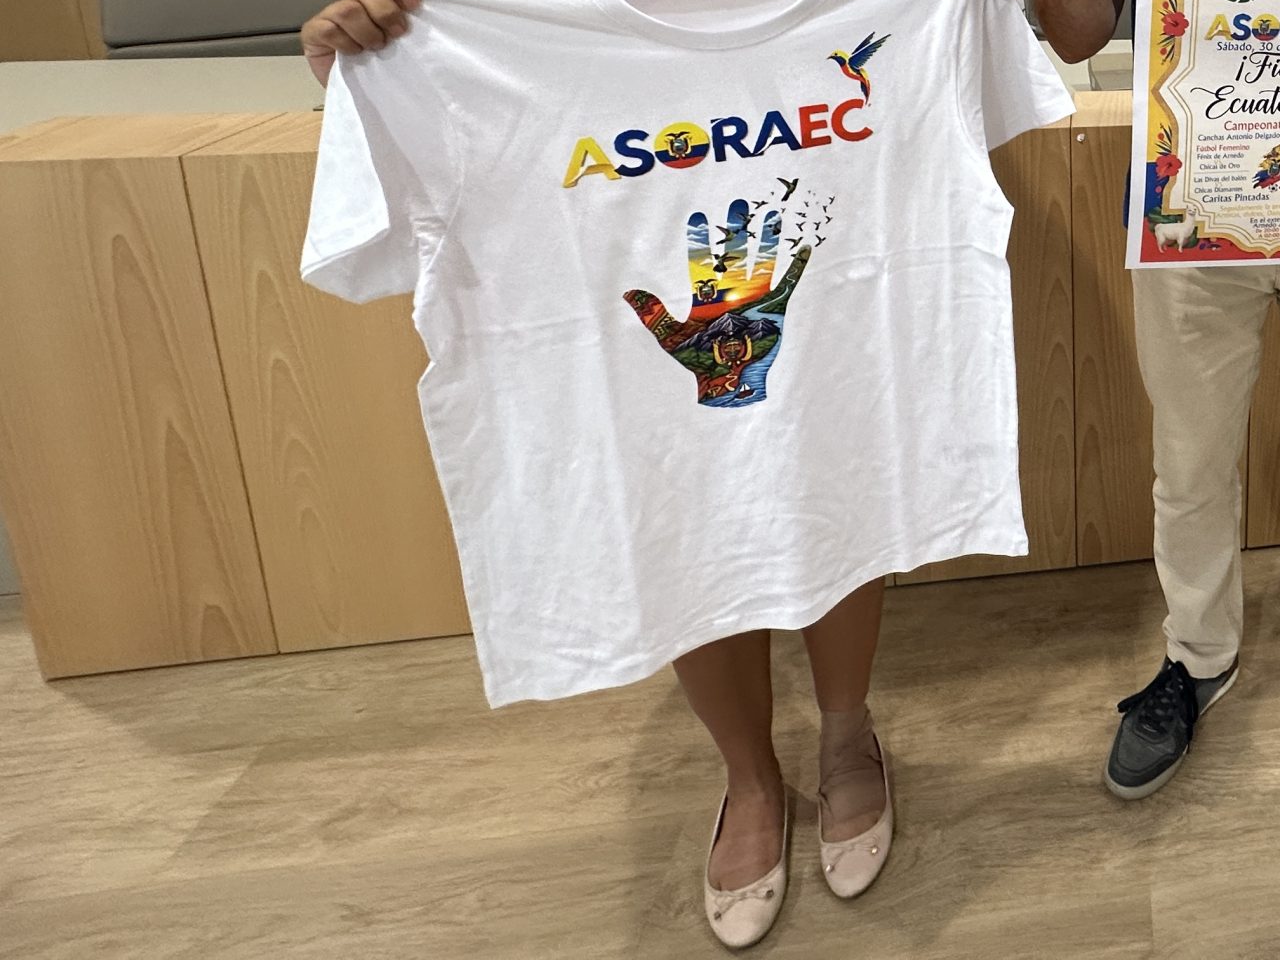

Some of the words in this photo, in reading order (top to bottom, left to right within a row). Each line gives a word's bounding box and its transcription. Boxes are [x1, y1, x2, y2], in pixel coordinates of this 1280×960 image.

[1217, 42, 1255, 52] Sábado,
[1259, 42, 1273, 51] 30
[562, 98, 873, 188] ASORAEC
[1202, 195, 1231, 203] Caritas
[1235, 193, 1269, 201] Pintadas
